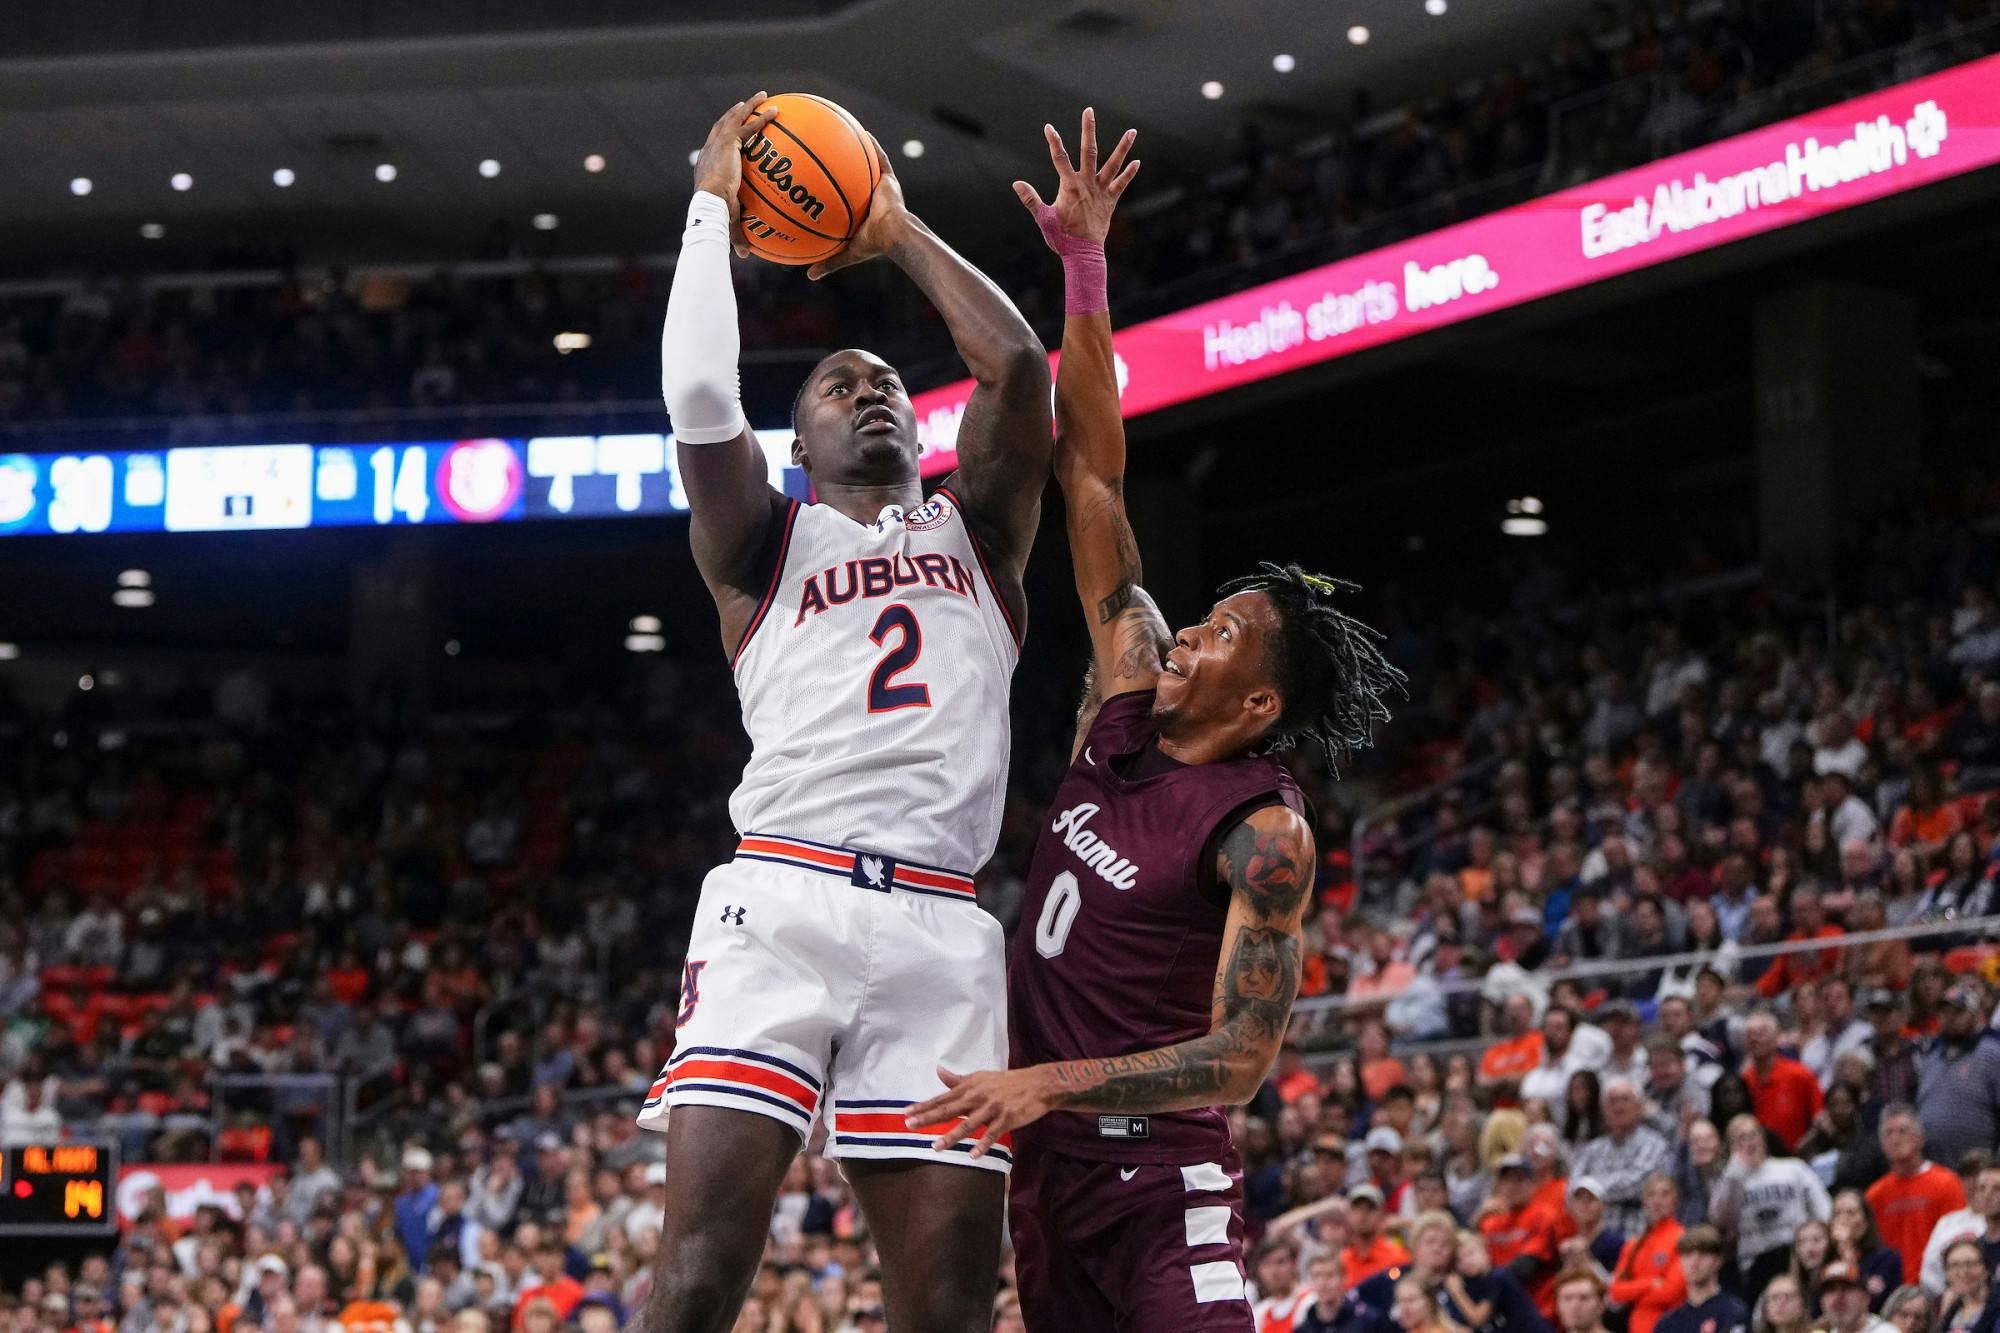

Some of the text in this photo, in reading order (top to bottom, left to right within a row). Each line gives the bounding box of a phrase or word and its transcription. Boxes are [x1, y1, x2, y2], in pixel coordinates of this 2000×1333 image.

[743, 132, 825, 221] Wilson
[1203, 254, 1499, 371] Health starts here.
[370, 446, 429, 523] 14
[908, 501, 940, 523] SEC
[794, 551, 981, 629] AUBURN
[867, 603, 932, 714] 2
[1036, 869, 1082, 960] 0
[1133, 1122, 1142, 1133] M
